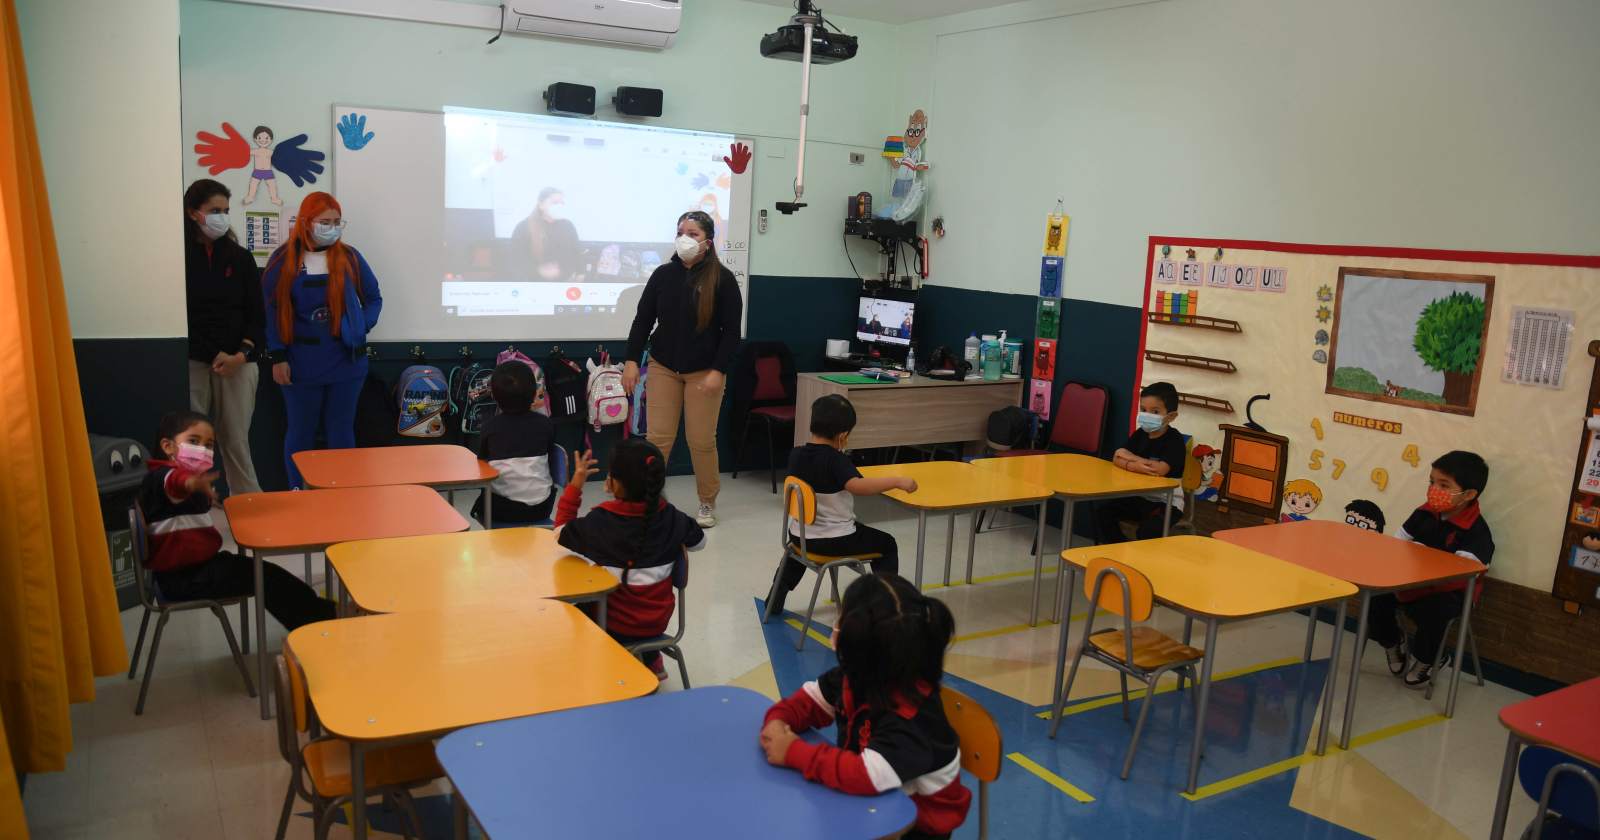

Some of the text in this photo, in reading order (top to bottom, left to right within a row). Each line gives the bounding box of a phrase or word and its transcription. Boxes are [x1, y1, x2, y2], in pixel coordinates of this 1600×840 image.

[404, 389, 447, 400] RACING
[1310, 417, 1324, 440] 1
[1335, 412, 1401, 433] numeros
[1308, 449, 1346, 480] 5 7
[1402, 444, 1420, 468] 4
[1370, 467, 1389, 492] 9
